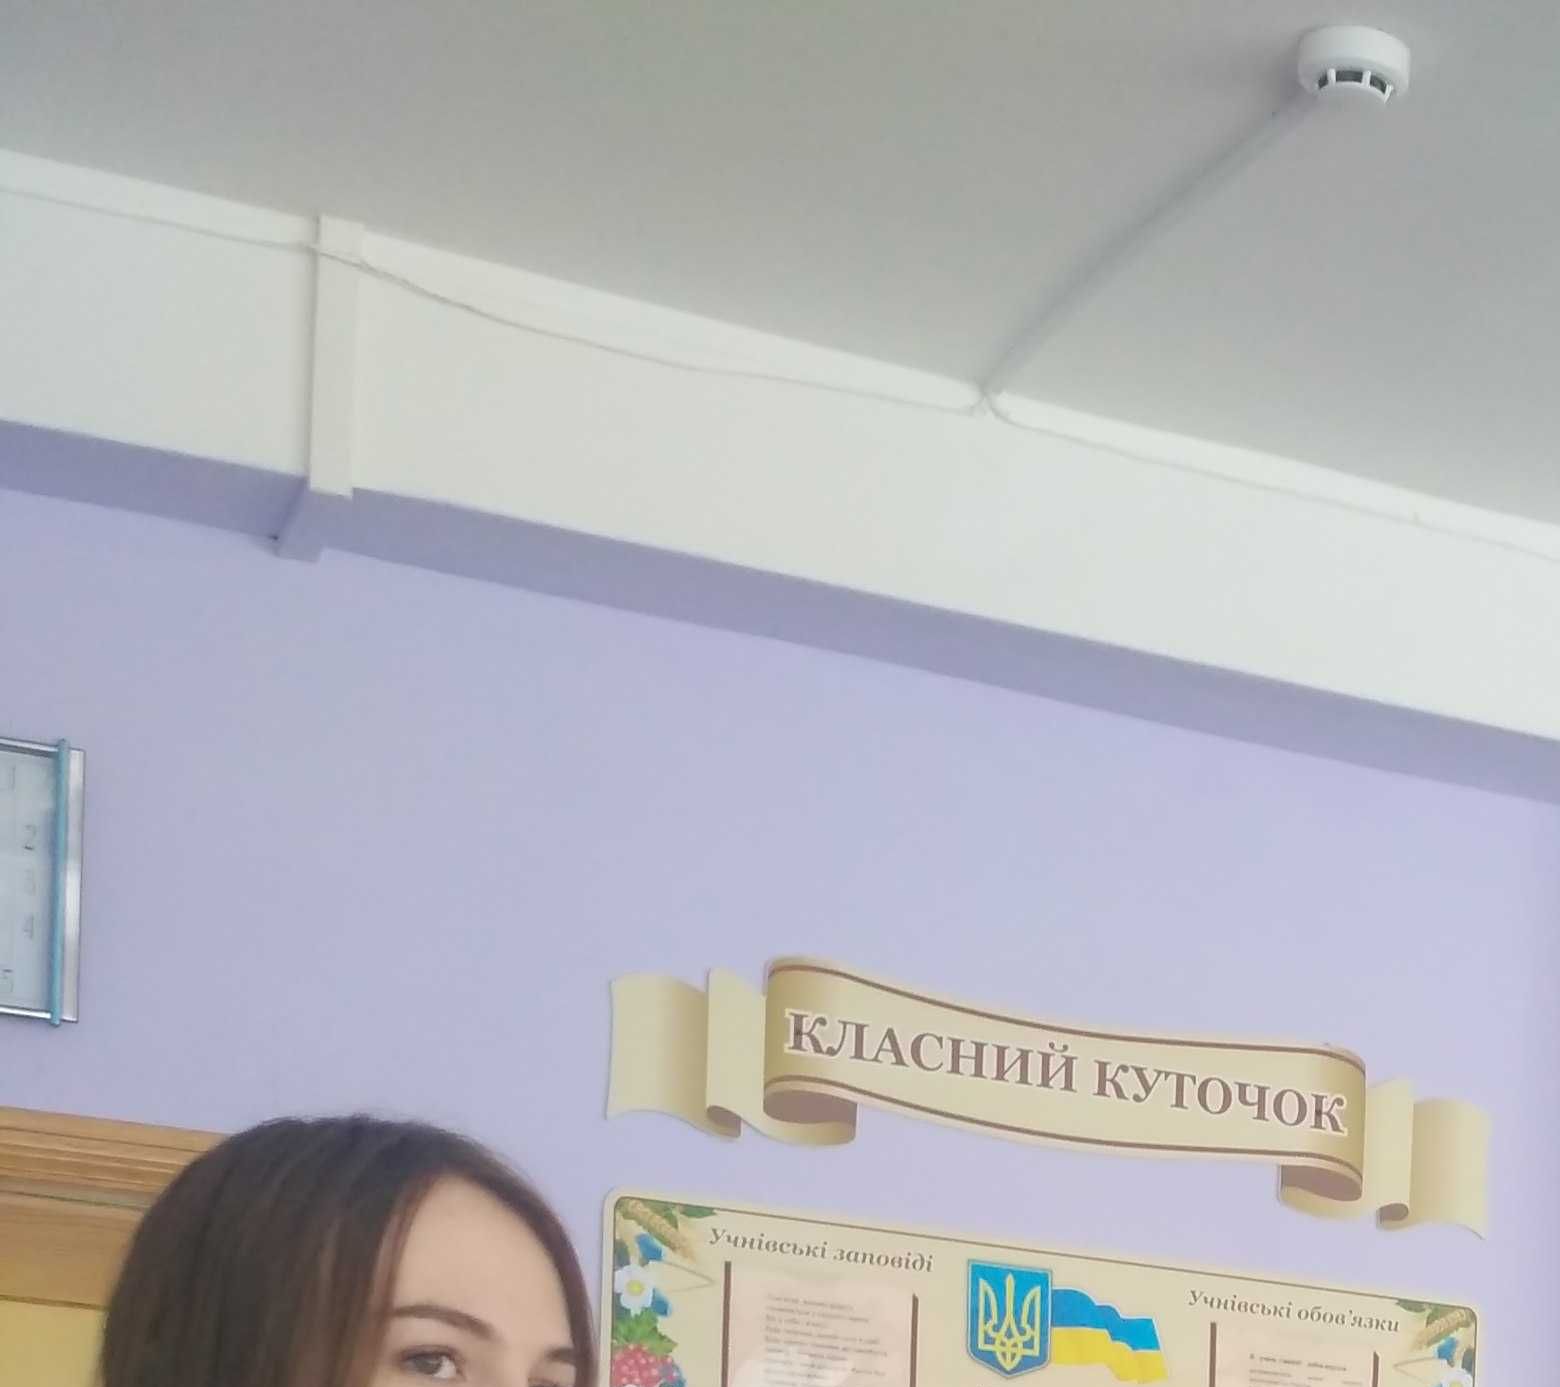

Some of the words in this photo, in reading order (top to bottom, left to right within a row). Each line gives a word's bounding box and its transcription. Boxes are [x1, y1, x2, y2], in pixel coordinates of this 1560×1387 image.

[789, 1011, 1078, 1091] КЛАСНИЙ
[1093, 1059, 1345, 1133] КУТОЧОК
[709, 1227, 828, 1259] Учнівські
[833, 1251, 934, 1273] заповіді
[1188, 1289, 1293, 1319] Учнівські
